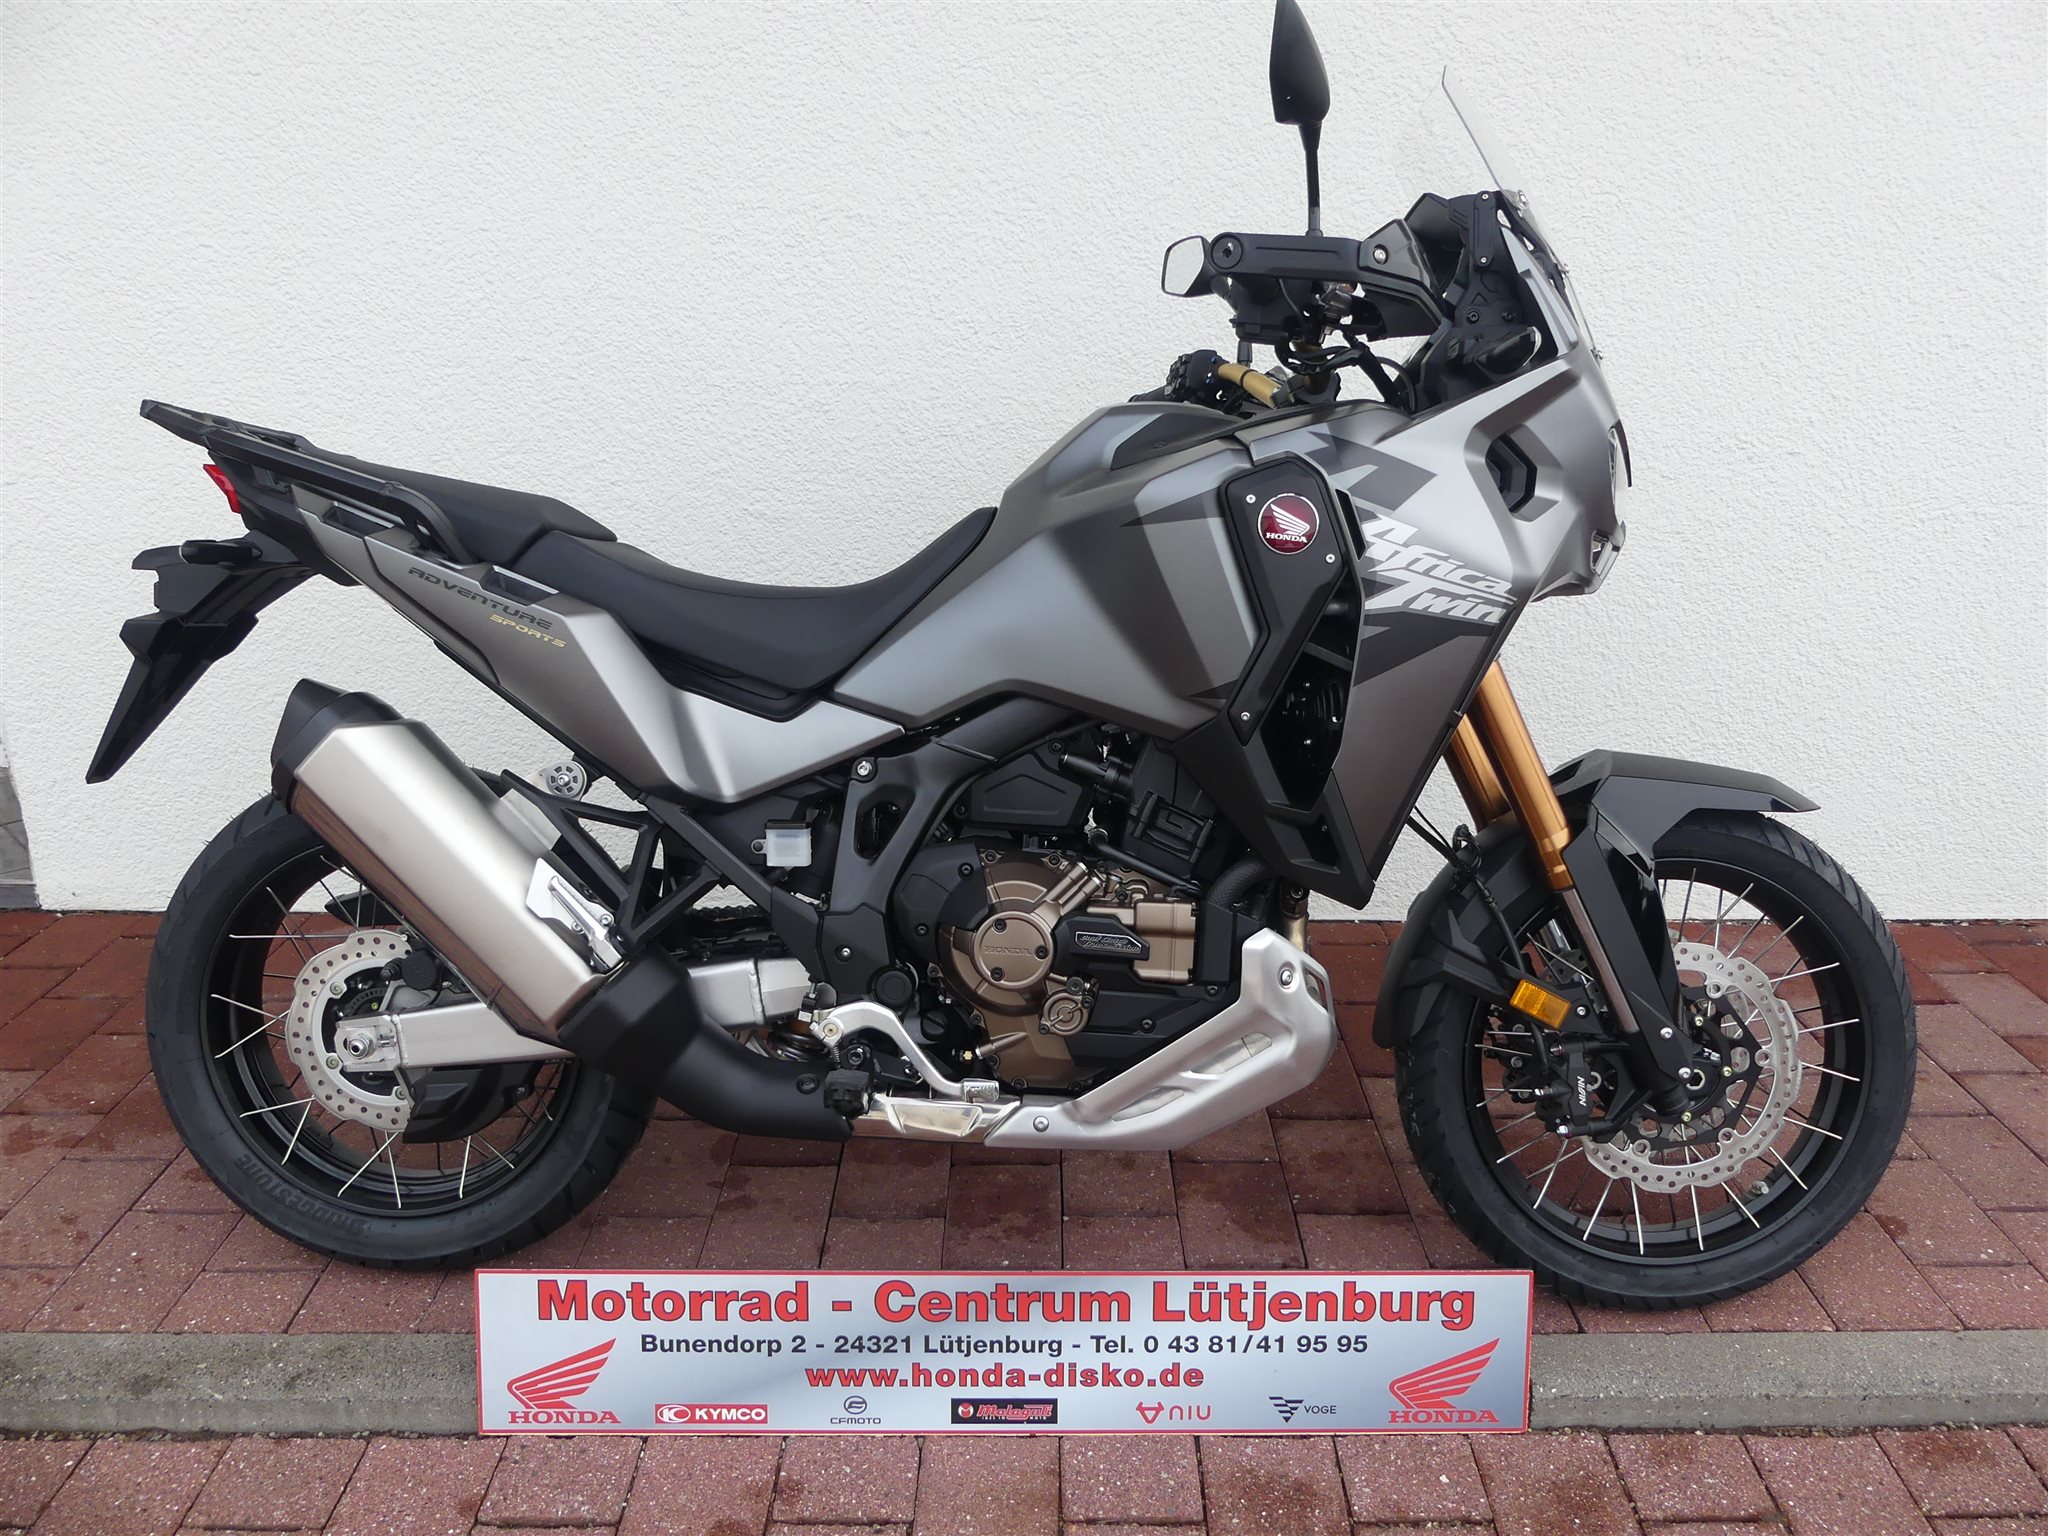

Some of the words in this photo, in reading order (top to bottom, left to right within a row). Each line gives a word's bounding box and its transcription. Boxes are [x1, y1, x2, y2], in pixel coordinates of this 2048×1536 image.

[1265, 532, 1308, 544] HONDA
[1361, 514, 1516, 599] Africa
[408, 566, 553, 630] ADVENTURE
[1365, 570, 1514, 623] Twin
[489, 613, 567, 648] SPORTS
[538, 1280, 810, 1323] Motorrad
[832, 1301, 852, 1311] -
[874, 1280, 1131, 1323] Centrum
[1153, 1281, 1475, 1331] Lütjenburg
[641, 1335, 782, 1356] Bunendorp
[791, 1335, 807, 1353] 2
[834, 1335, 911, 1353] 24321
[924, 1334, 1062, 1356] Lütjenburg
[1090, 1335, 1134, 1353] Tel.
[1143, 1335, 1159, 1353] 0
[1168, 1335, 1199, 1353] 43
[1208, 1335, 1284, 1354] 81/41
[1296, 1335, 1328, 1353] 95
[1337, 1335, 1368, 1353] 95
[805, 1362, 1204, 1388] www.honda-disko.de
[509, 1410, 621, 1424] HONDA
[695, 1407, 767, 1421] KYMCO
[976, 1404, 1054, 1420] Malaguti
[1303, 1405, 1337, 1415] VOGE
[1388, 1409, 1500, 1424] HONDA
[830, 1417, 882, 1425] CFMOTO
